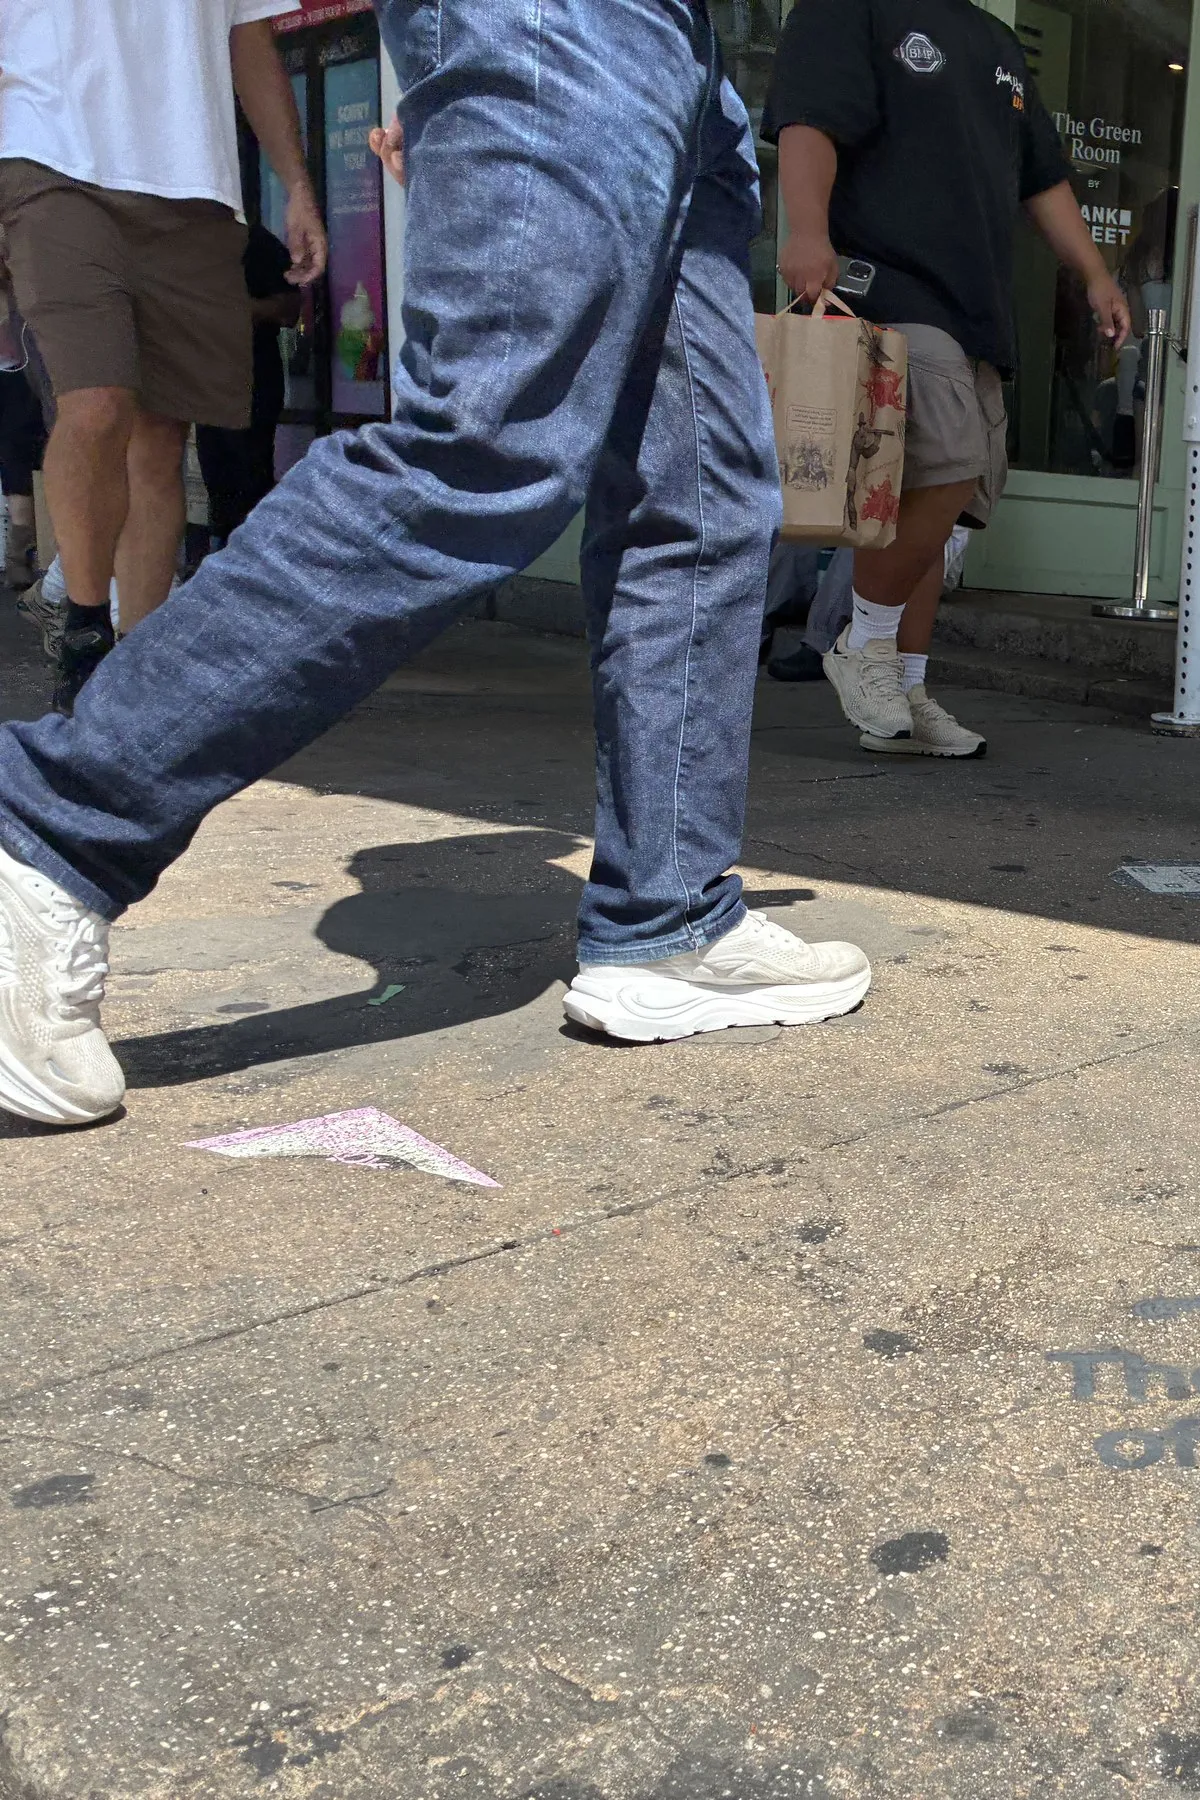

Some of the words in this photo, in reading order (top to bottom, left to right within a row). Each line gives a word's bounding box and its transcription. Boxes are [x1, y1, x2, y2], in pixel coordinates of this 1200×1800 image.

[1053, 112, 1085, 135] The
[1090, 118, 1142, 144] Green
[1071, 138, 1120, 163] Room
[1088, 179, 1100, 188] BY
[1081, 204, 1119, 225] ANK
[1087, 225, 1130, 245] EET
